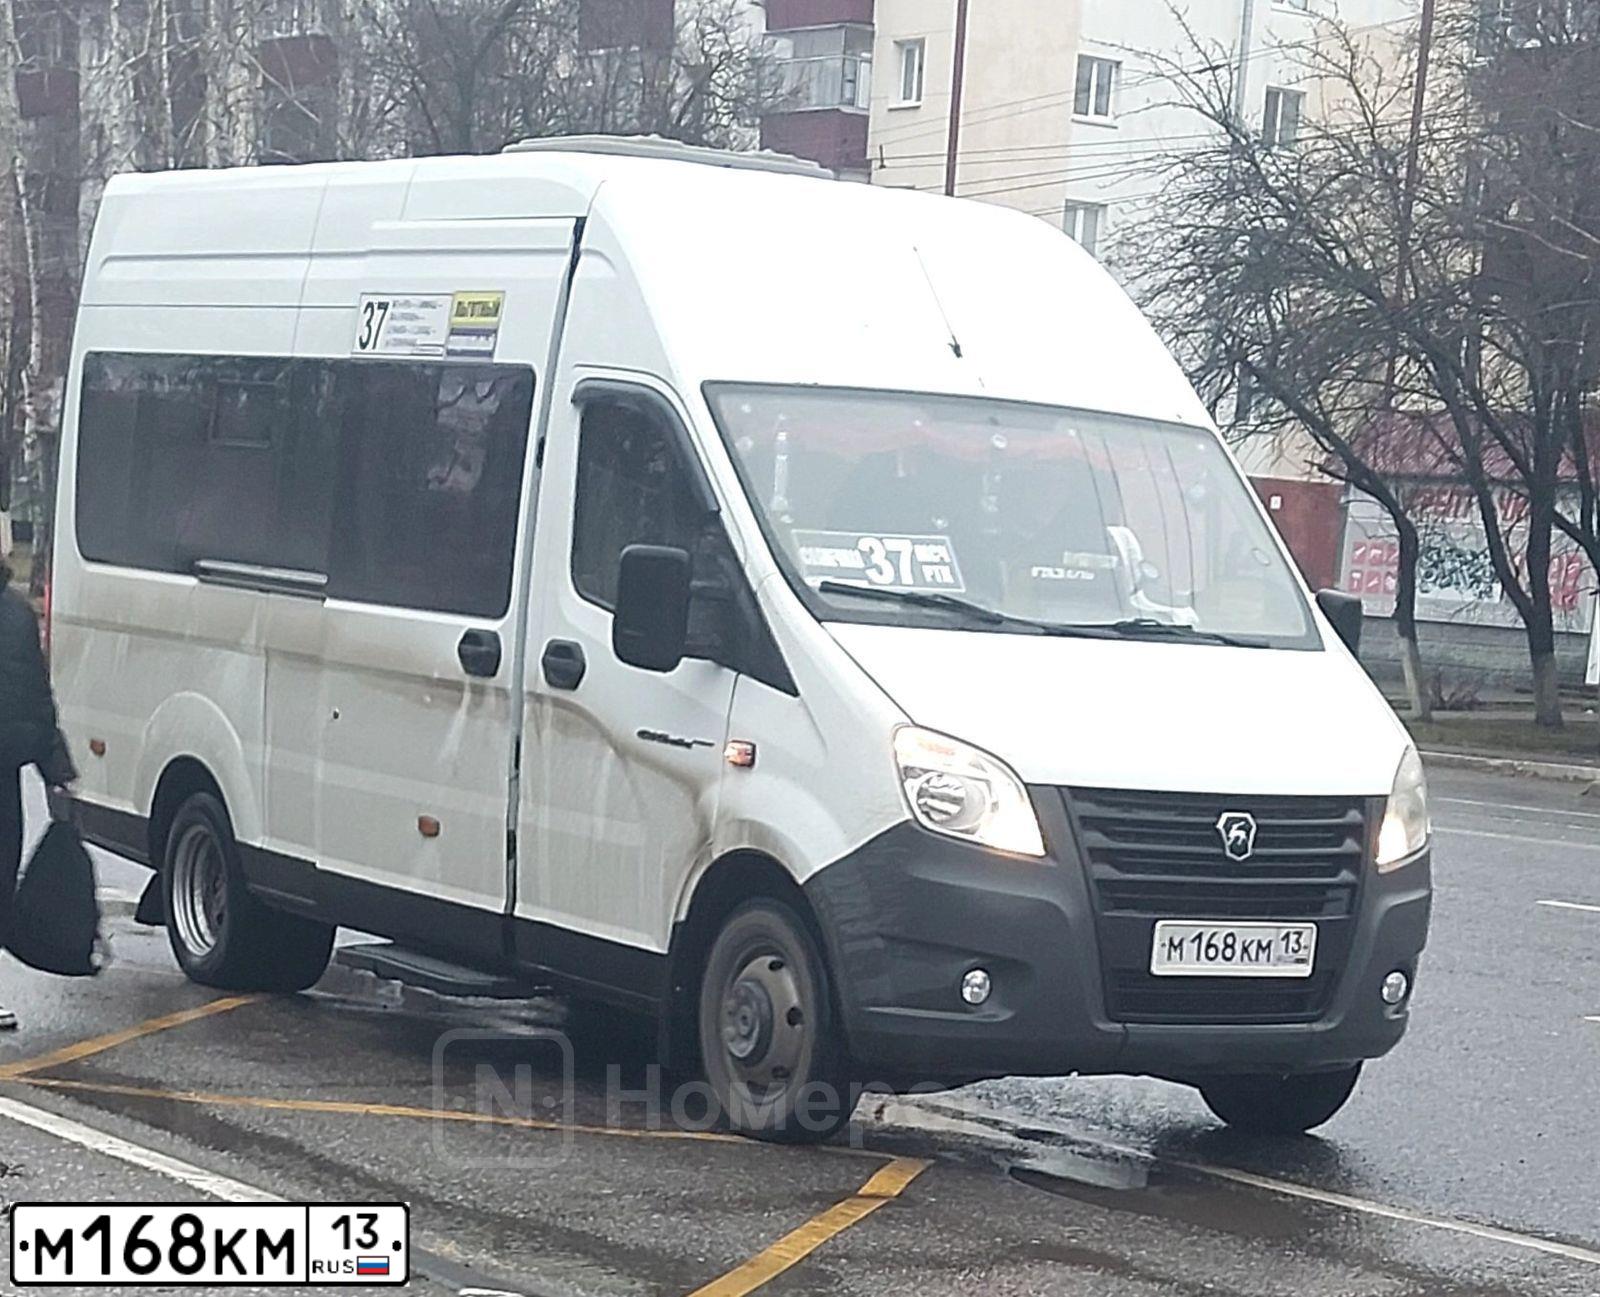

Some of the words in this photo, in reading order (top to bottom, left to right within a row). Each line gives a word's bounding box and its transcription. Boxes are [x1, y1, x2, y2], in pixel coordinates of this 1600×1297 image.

[358, 301, 390, 350] 37
[857, 537, 914, 585] 37
[1280, 931, 1304, 954] 13
